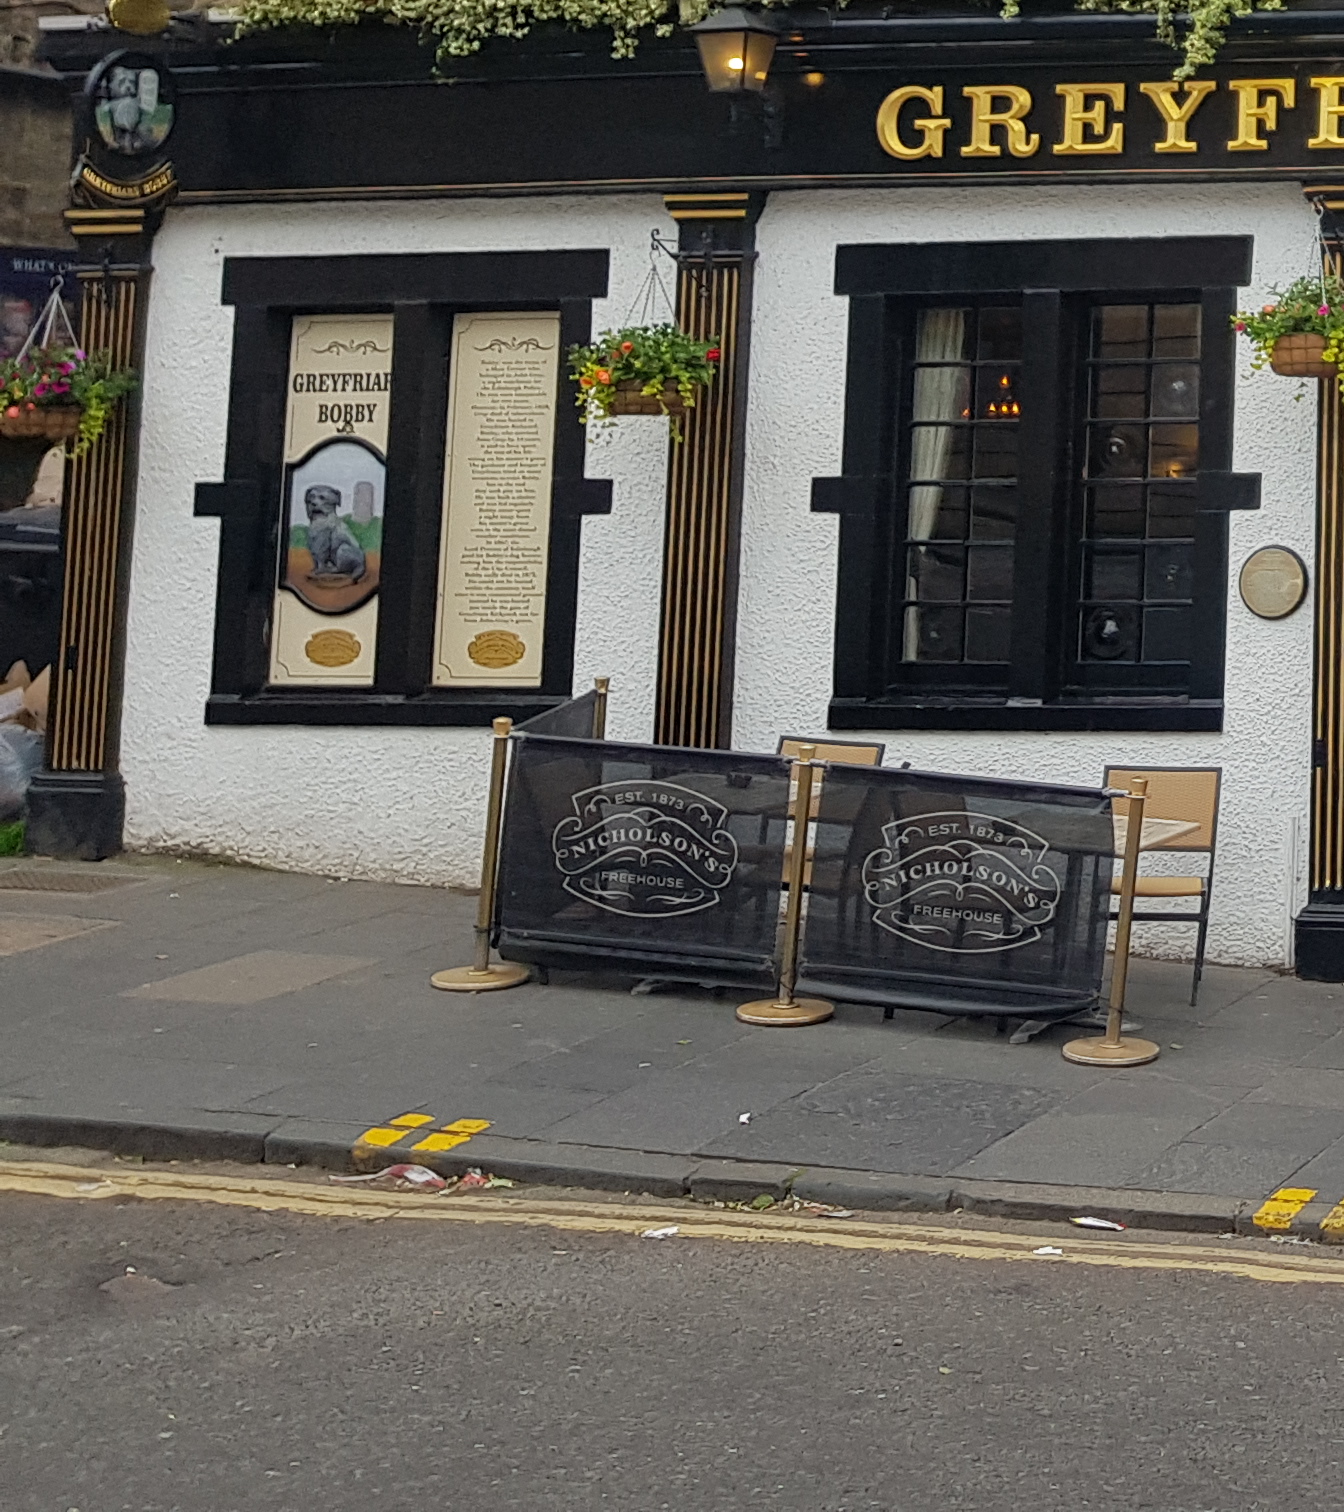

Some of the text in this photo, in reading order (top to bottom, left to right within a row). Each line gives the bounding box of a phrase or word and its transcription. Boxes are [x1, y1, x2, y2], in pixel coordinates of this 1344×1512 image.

[317, 403, 377, 423] BOBBY
[614, 791, 685, 810] EST. 1873
[928, 823, 1004, 843] EST. 1873
[570, 827, 719, 872] NICHOLSON'S
[600, 870, 685, 889] FREEHOUSE
[881, 860, 1039, 908] NICHOLSON'S
[913, 904, 1003, 924] FREEHOUSE
